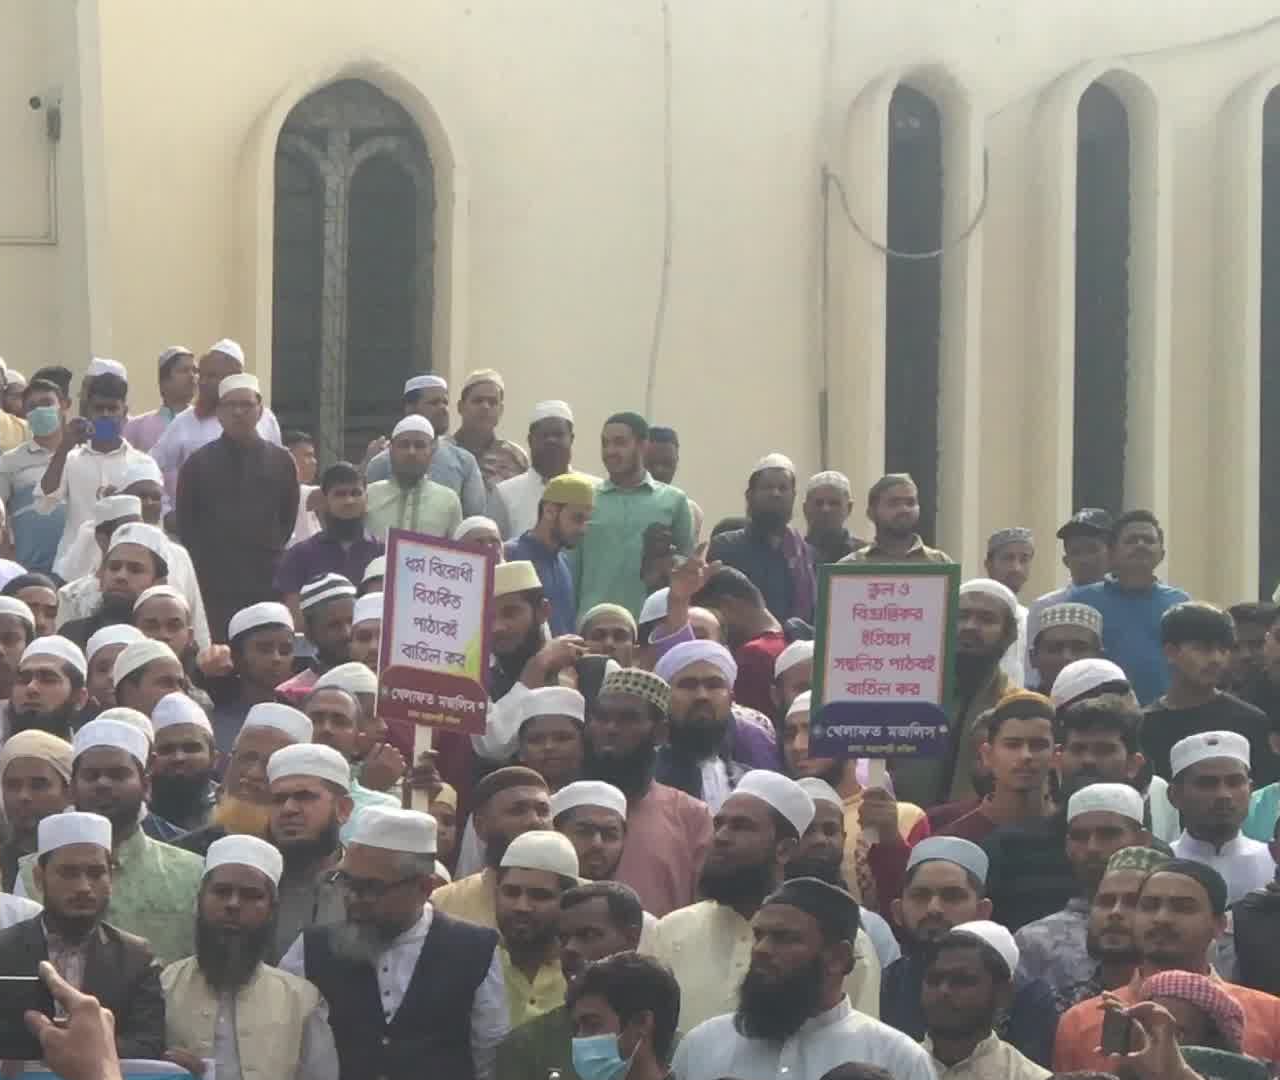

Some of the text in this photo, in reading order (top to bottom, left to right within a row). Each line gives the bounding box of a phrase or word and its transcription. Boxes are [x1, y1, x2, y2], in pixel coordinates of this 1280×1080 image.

[899, 584, 911, 596] ও
[401, 643, 466, 667] বাতিল কর
[846, 679, 921, 697] বাতিল কর
